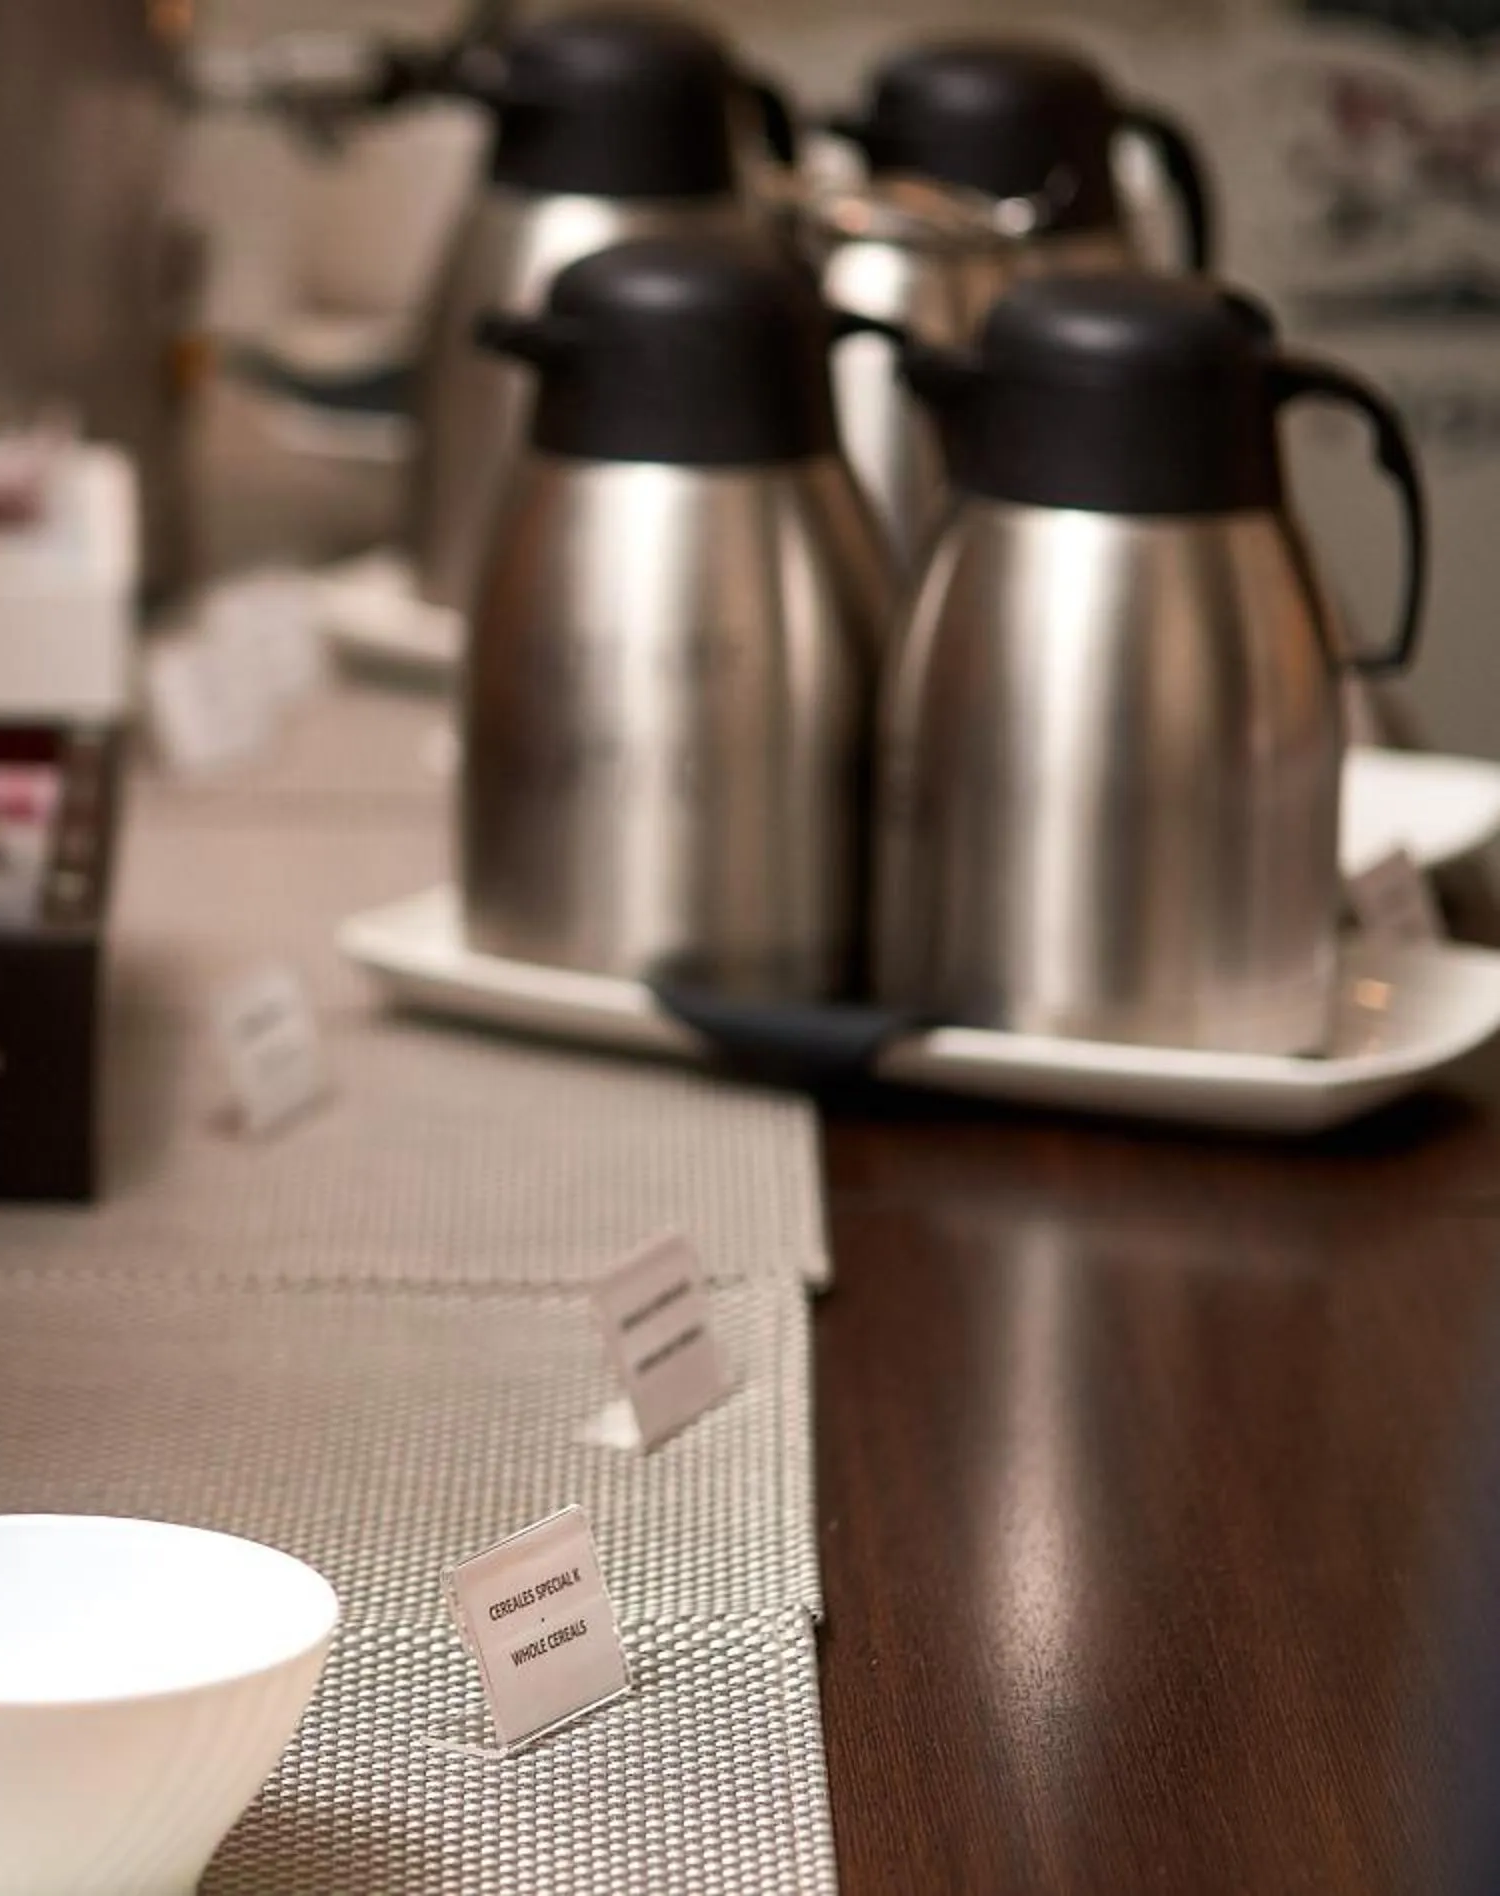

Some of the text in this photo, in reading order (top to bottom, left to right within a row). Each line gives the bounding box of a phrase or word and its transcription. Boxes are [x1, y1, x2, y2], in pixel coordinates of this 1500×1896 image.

[489, 1567, 582, 1621] CEREALES SPECIAL K
[511, 1619, 588, 1667] WHOLE CEREALS
